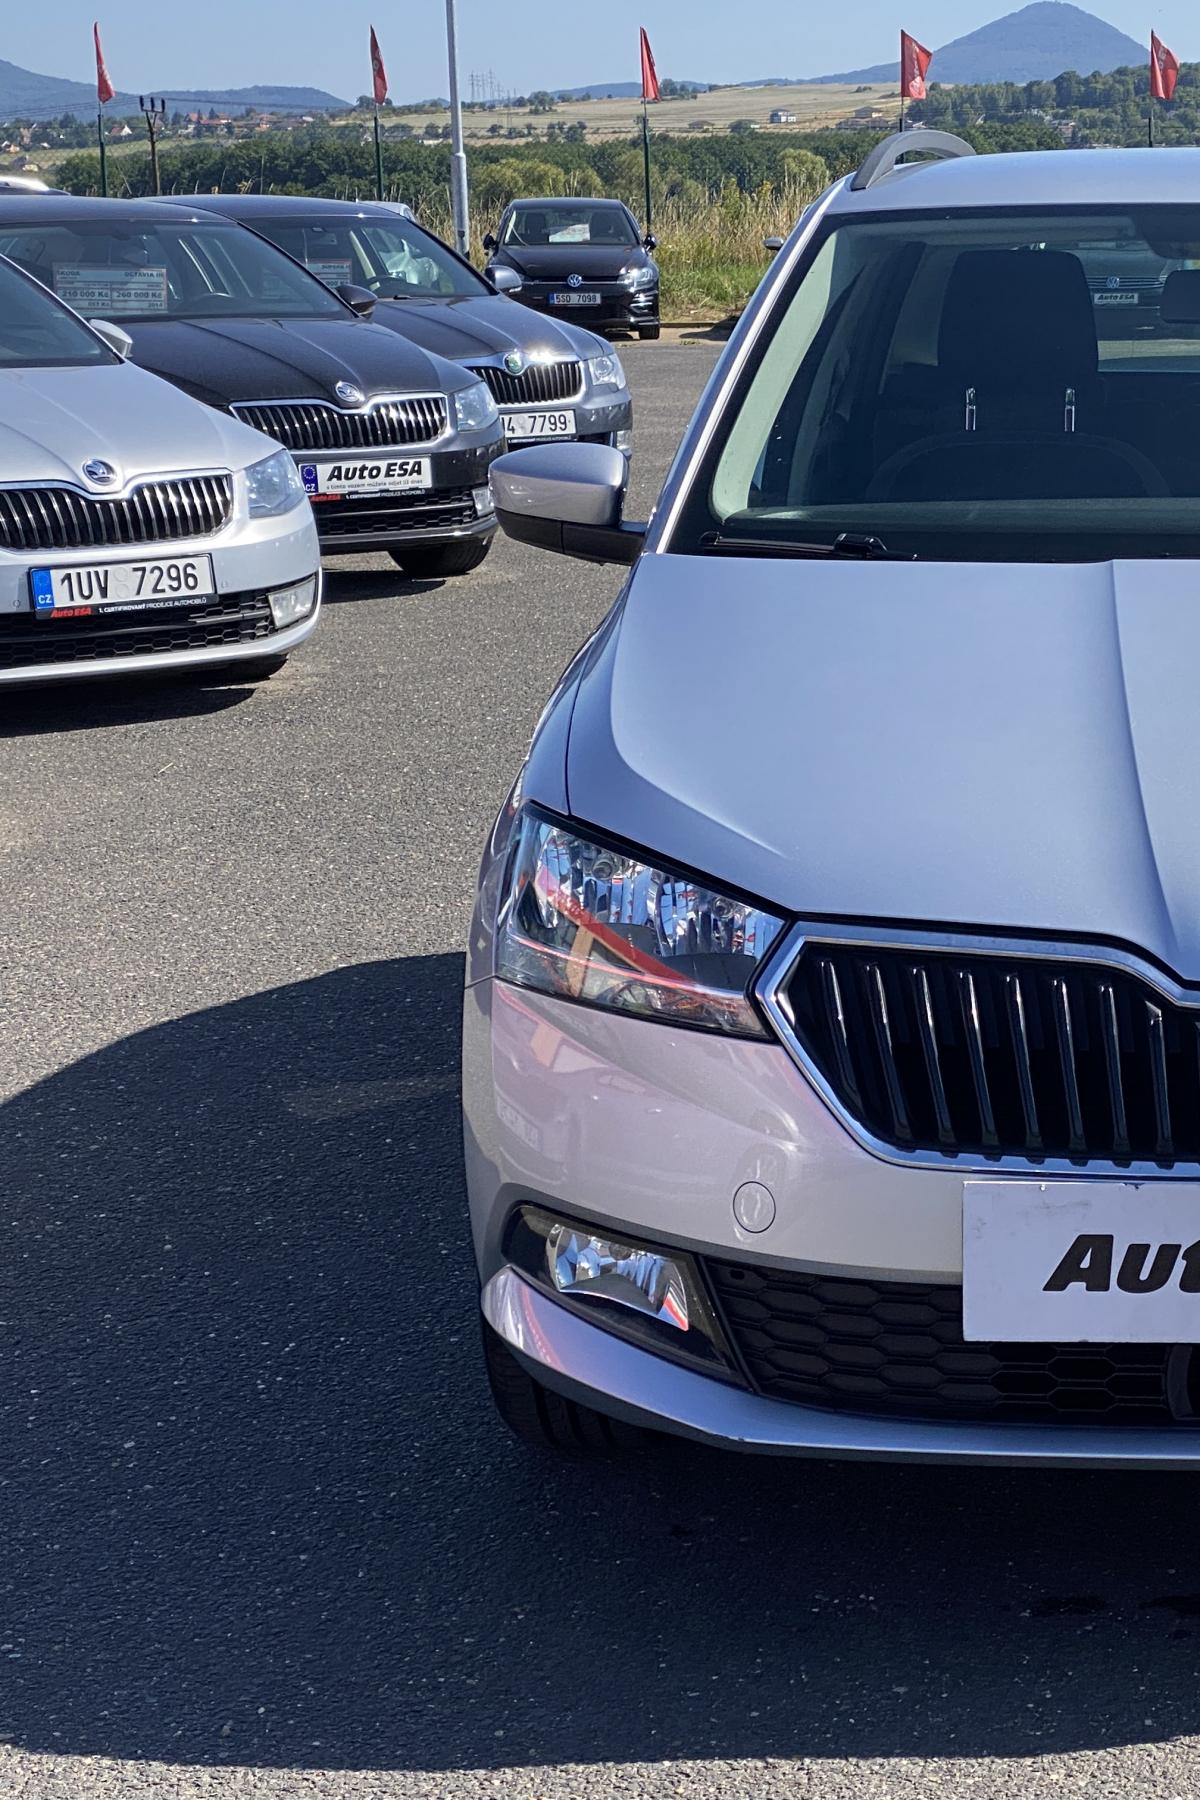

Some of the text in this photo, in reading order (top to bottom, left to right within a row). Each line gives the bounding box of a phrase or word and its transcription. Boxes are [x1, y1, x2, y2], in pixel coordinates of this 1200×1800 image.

[80, 290, 95, 298] 000
[528, 414, 568, 433] 7799
[327, 460, 422, 481] Auto ESA
[306, 484, 316, 492] CZ
[60, 563, 198, 601] 1UV 7296
[38, 594, 52, 604] CZ
[50, 607, 92, 618] Auto ESA
